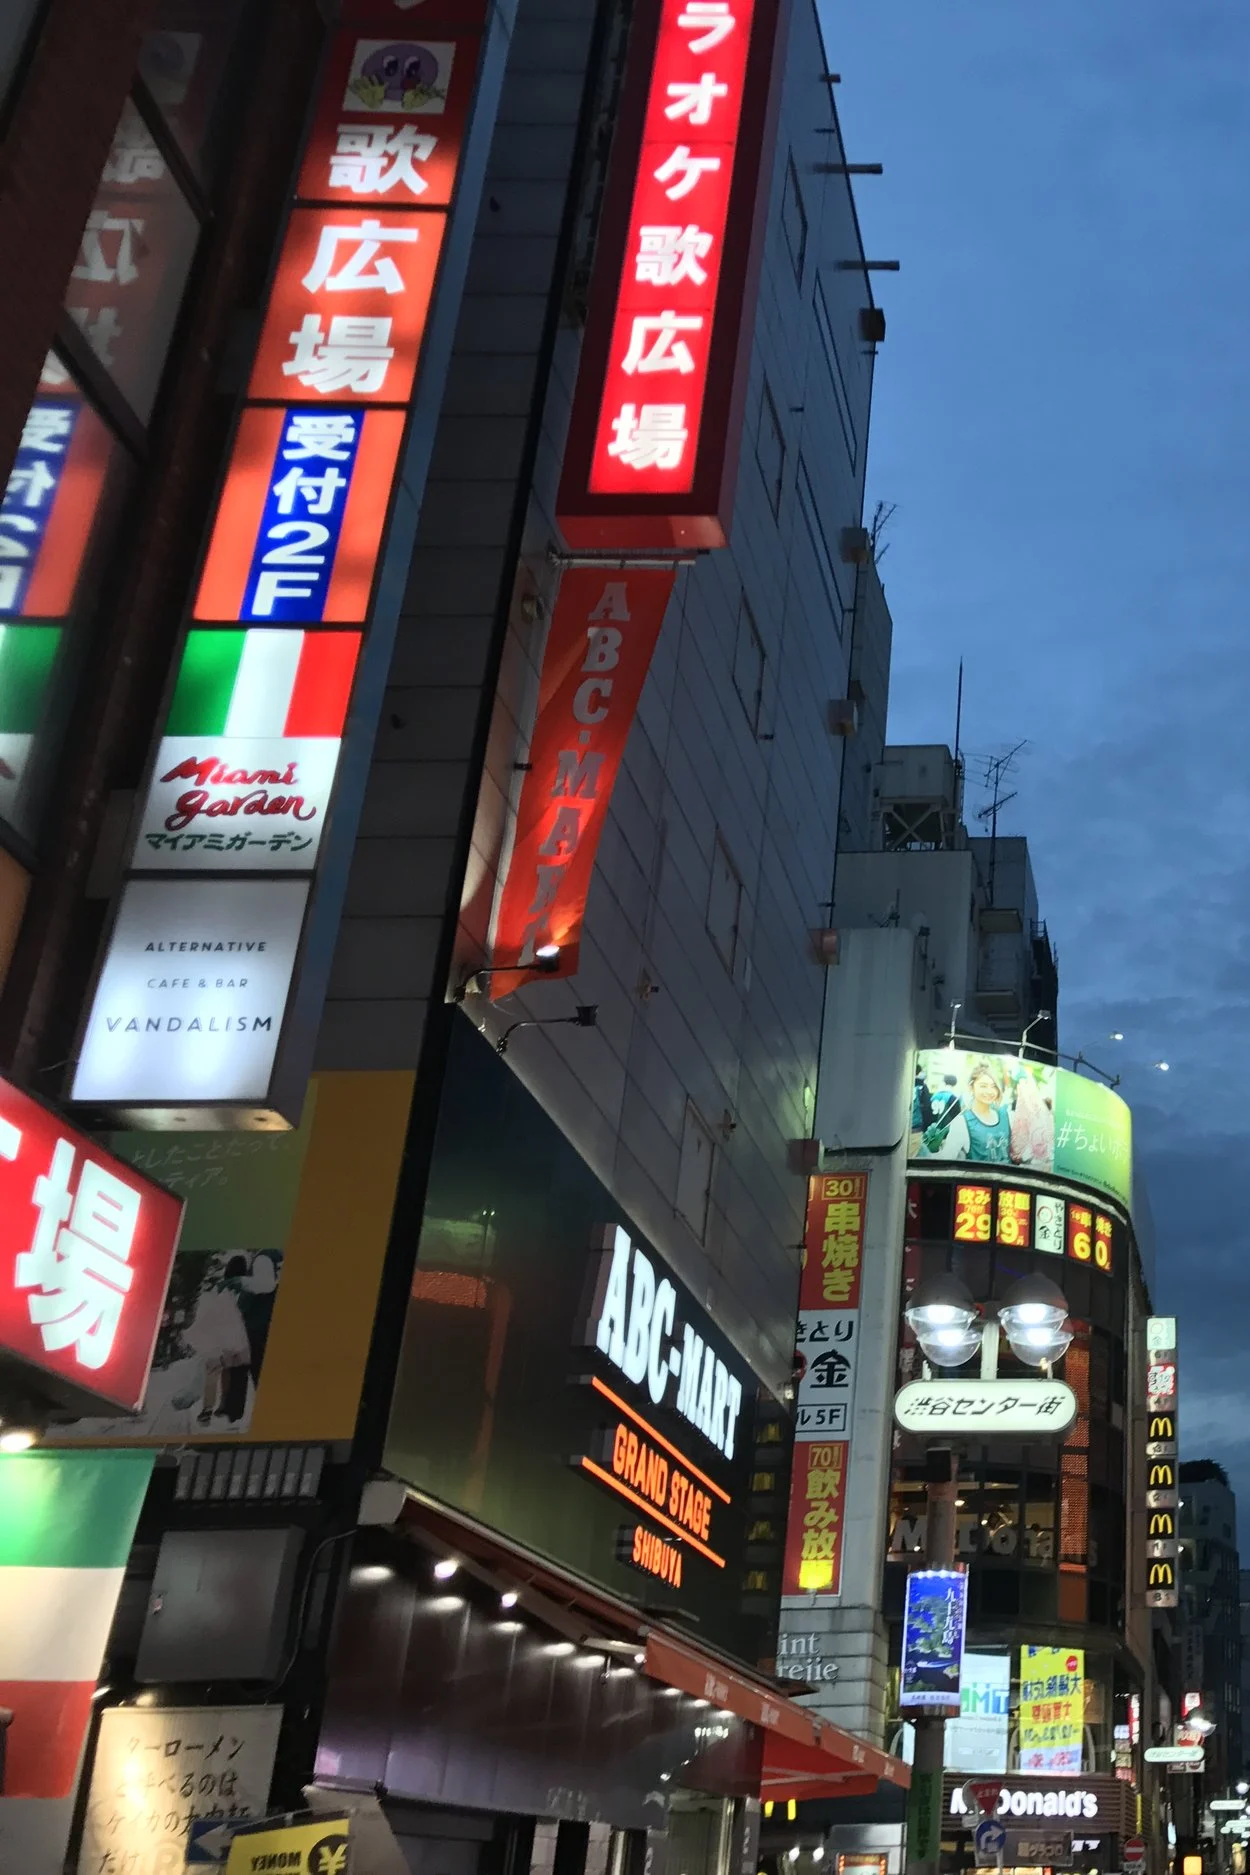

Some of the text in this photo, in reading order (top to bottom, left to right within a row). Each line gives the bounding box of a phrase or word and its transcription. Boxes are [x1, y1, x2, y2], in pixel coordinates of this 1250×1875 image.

[282, 125, 438, 395] 歌広場
[251, 414, 356, 617] 受付2F
[161, 756, 297, 788] Miami
[145, 832, 313, 853] マイアミガーデン
[145, 940, 268, 954] ALTERNATIVE
[147, 977, 199, 991] CAFE
[215, 976, 248, 989] BAR
[106, 1016, 273, 1034] VANDALISM
[821, 1201, 861, 1302] 串焼き
[596, 1223, 742, 1460] ABC-MART
[810, 1349, 851, 1389] 金
[904, 1396, 1067, 1417] 渋谷センター街
[613, 1422, 713, 1543] GRAND STAGE
[633, 1524, 683, 1590] SHIBUYA
[801, 1470, 842, 1591] 飲み放
